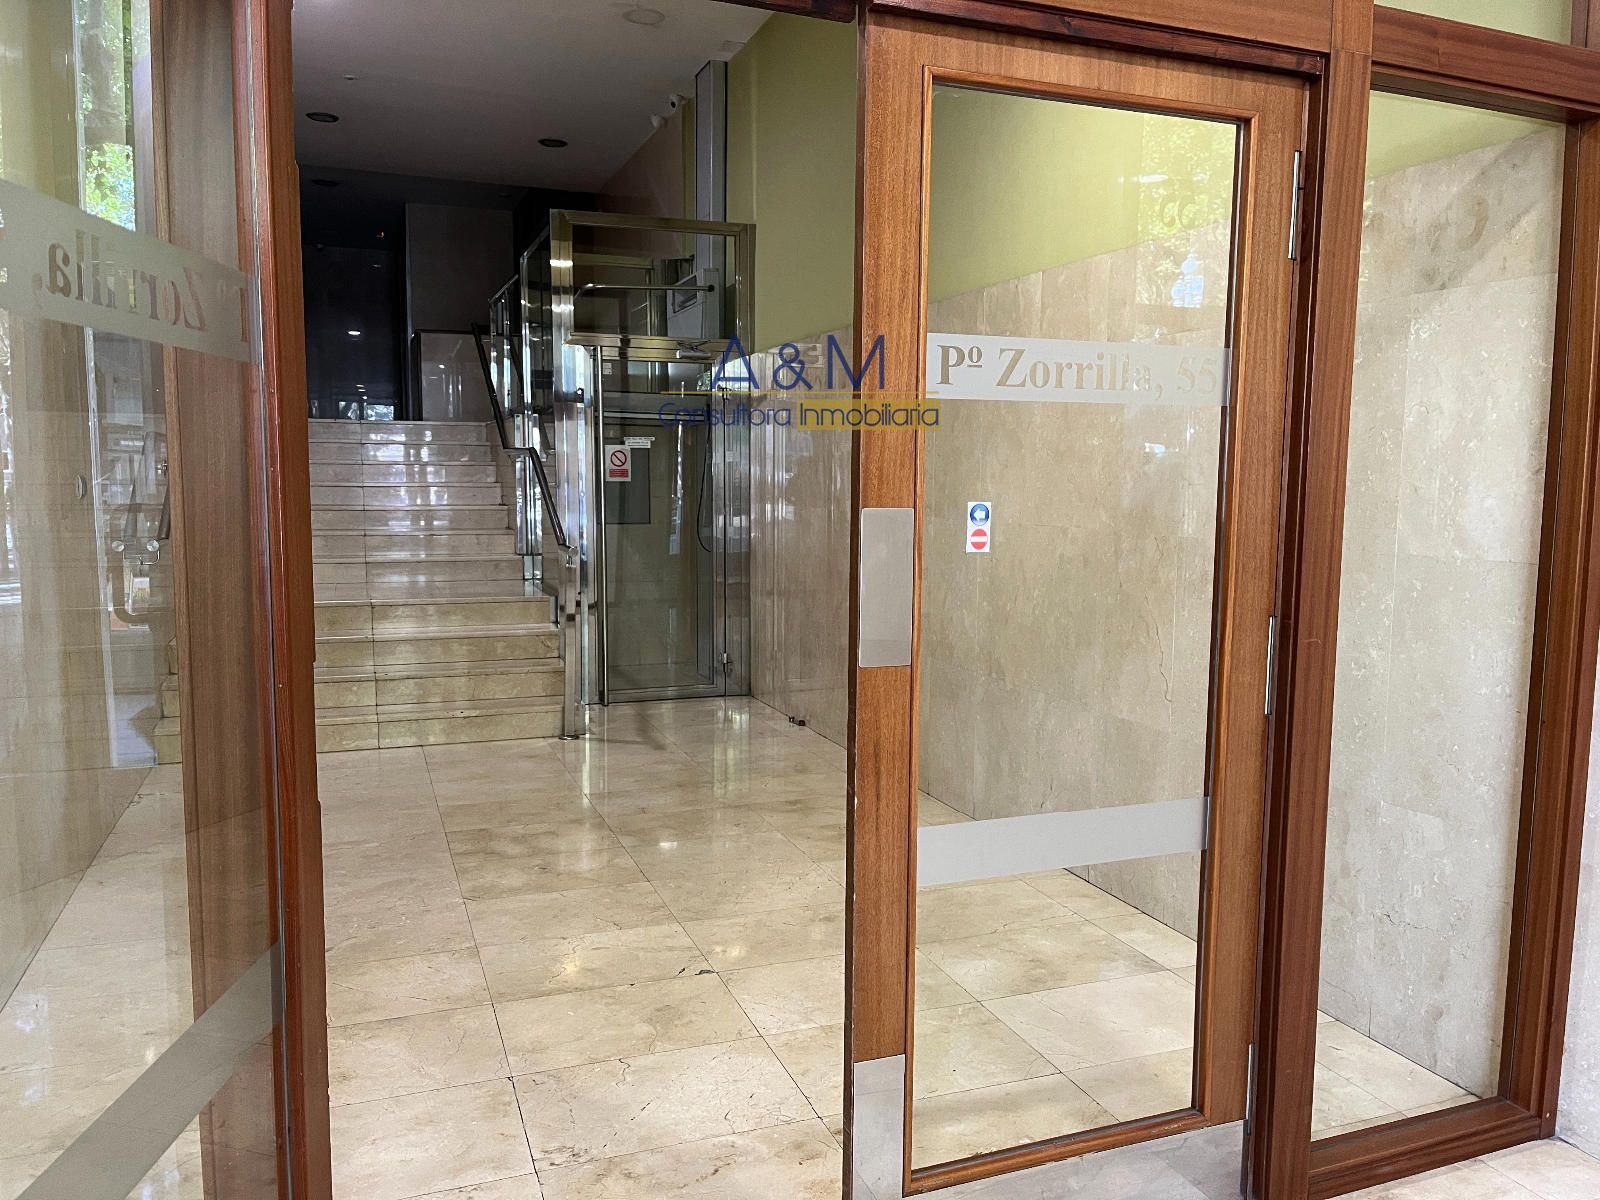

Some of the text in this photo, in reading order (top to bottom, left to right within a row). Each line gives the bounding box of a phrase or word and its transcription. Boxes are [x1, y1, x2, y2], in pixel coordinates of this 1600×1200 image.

[936, 344, 1218, 398] Pº Zorrilla, 55
